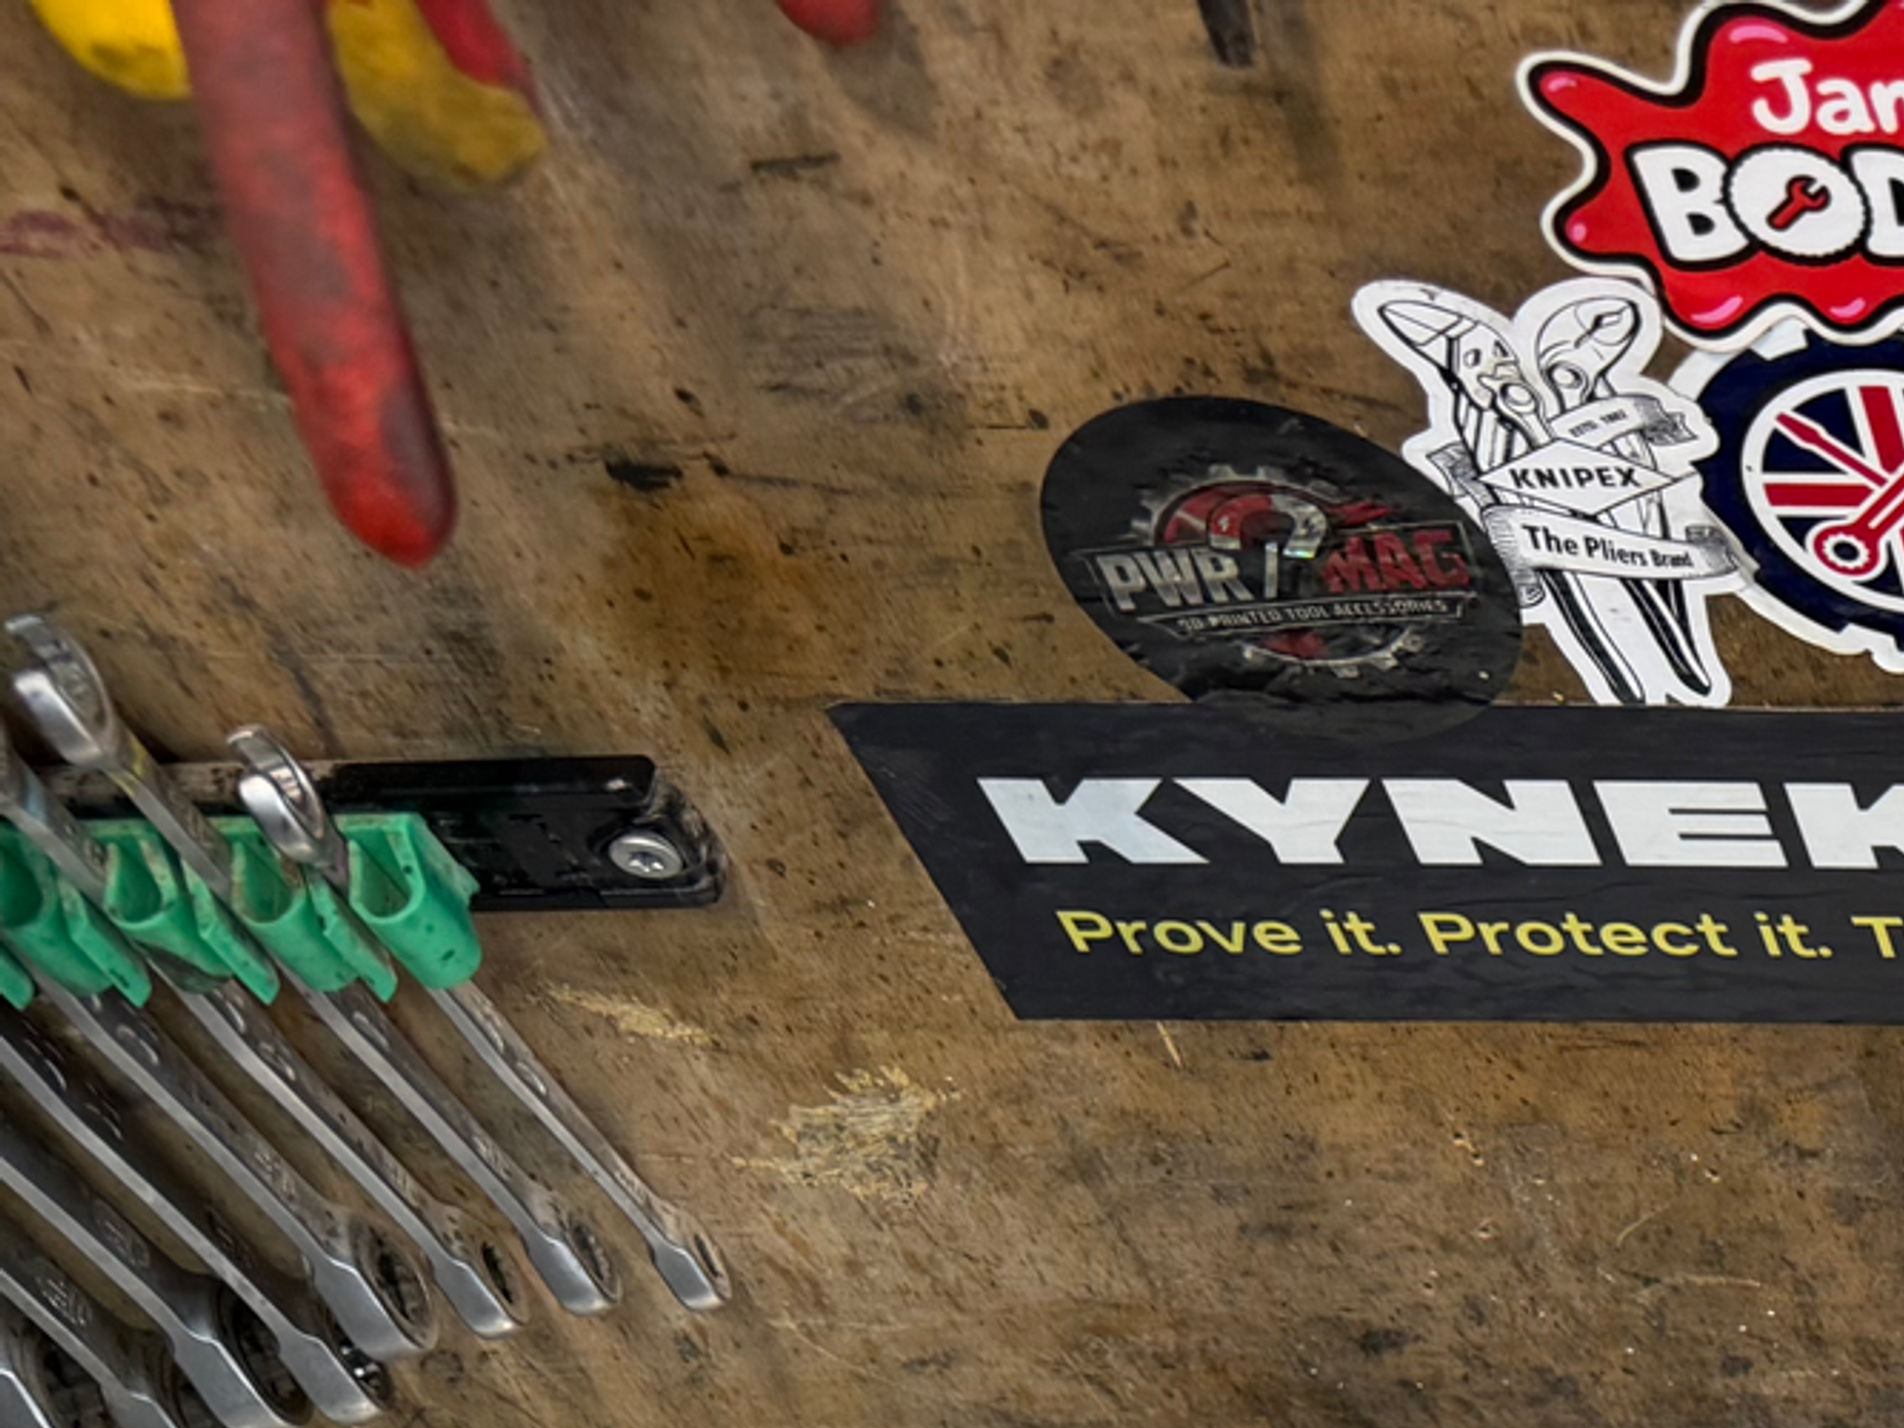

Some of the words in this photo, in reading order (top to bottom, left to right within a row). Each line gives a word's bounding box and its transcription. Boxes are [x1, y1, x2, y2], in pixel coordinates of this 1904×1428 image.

[1510, 466, 1641, 489] KNIPEX
[1522, 524, 1578, 555] The
[1584, 536, 1647, 568] Pliers
[1651, 549, 1694, 568] Brand
[1096, 548, 1254, 611] PWR
[1320, 530, 1470, 593] MAG
[1285, 604, 1328, 621] TOOL
[1056, 909, 1302, 955] Prove
[1319, 908, 1402, 955] it.
[1417, 911, 1738, 957] Protect
[1755, 912, 1833, 958] it.
